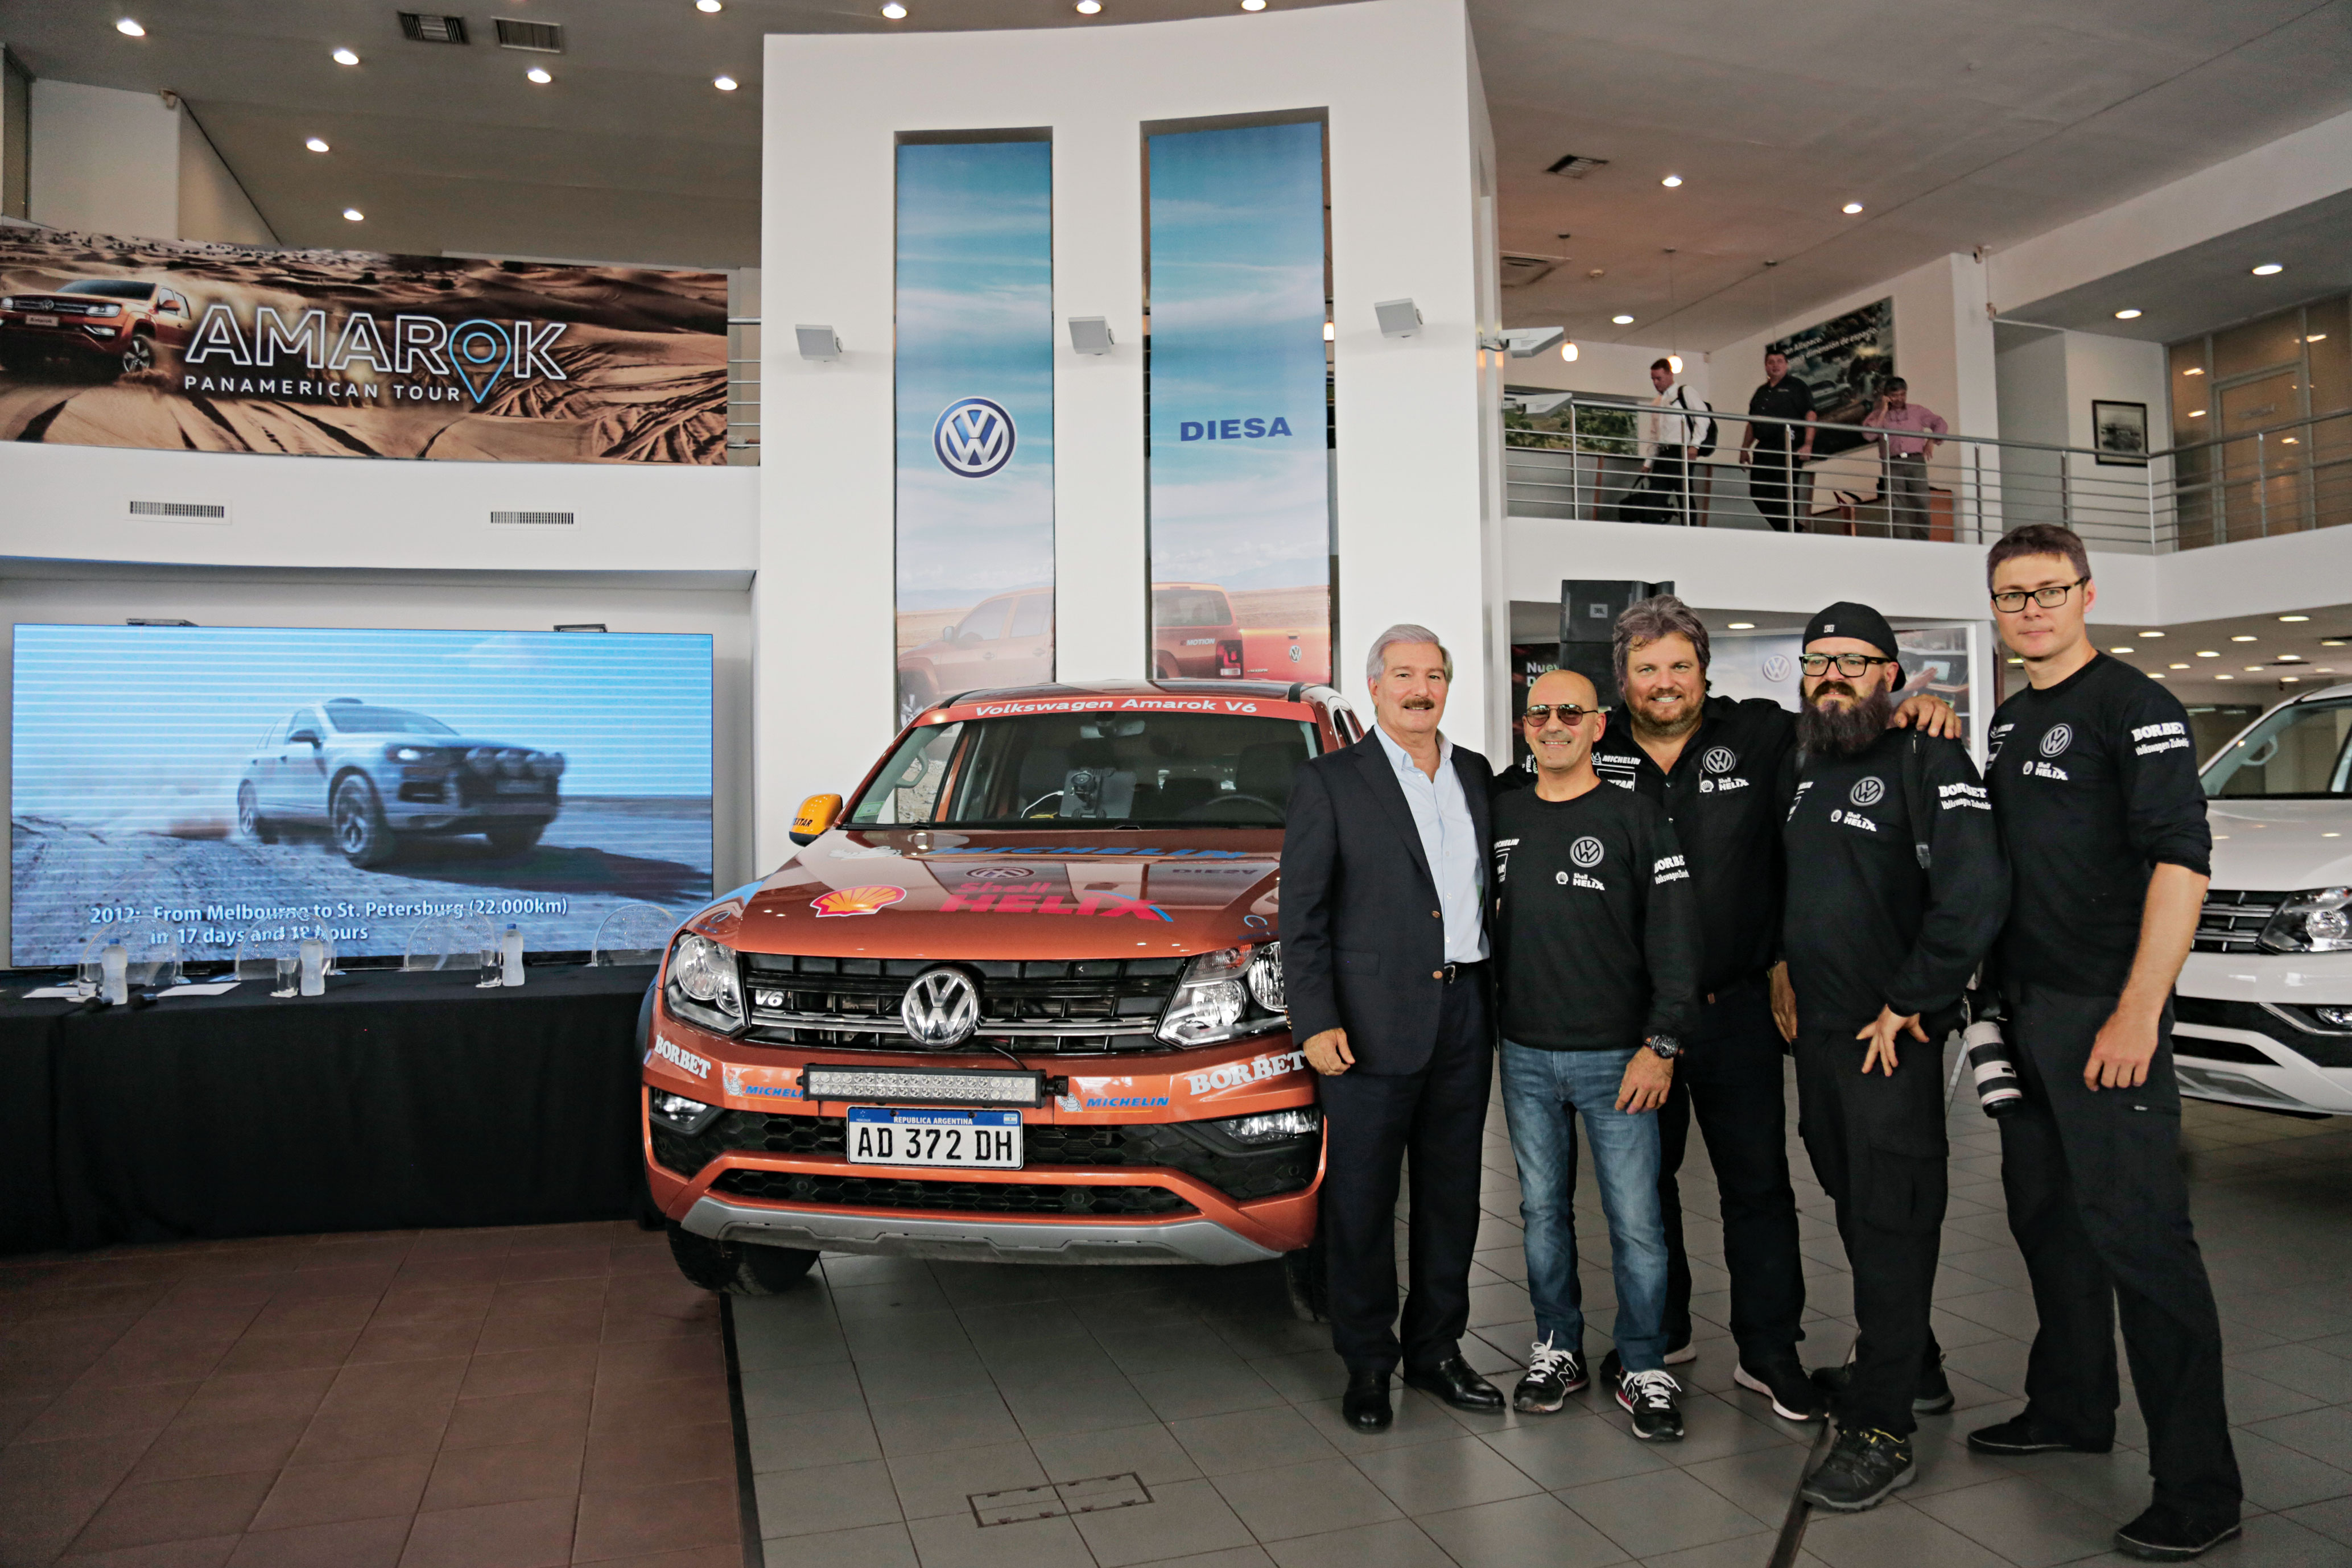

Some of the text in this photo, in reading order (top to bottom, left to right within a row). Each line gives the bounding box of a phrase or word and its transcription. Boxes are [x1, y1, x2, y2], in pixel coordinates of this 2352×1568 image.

[185, 304, 567, 403] AMAROK
[185, 376, 460, 402] PANAMERICAN TOUR
[1181, 416, 1293, 441] DIESA
[1526, 662, 1560, 674] Nuev
[976, 699, 1257, 716] Volkswagen Amarok V6
[1602, 754, 1641, 765] MICHELIN
[2035, 767, 2068, 781] HELIX
[1719, 779, 1749, 791] HELIX
[1843, 816, 1877, 832] HELIX
[927, 847, 1249, 859] MICHELIN
[955, 882, 1051, 893] Shell
[1573, 878, 1605, 890] HELIX
[90, 897, 568, 924] 2012: From Melbourne to St. Petersburg (22.000km)
[939, 894, 1161, 922] HELIX
[150, 929, 168, 944] in
[178, 928, 198, 944] 17
[203, 927, 245, 947] days
[250, 926, 285, 942] and
[756, 989, 785, 1007] V6
[654, 1034, 711, 1079] BORBET
[1187, 1050, 1305, 1096] BORBET
[745, 1086, 803, 1098] MICHELI
[1086, 1097, 1169, 1107] MICHELIN
[933, 1117, 973, 1125] ARGENTINA
[857, 1127, 1012, 1161] AD 372 DH
